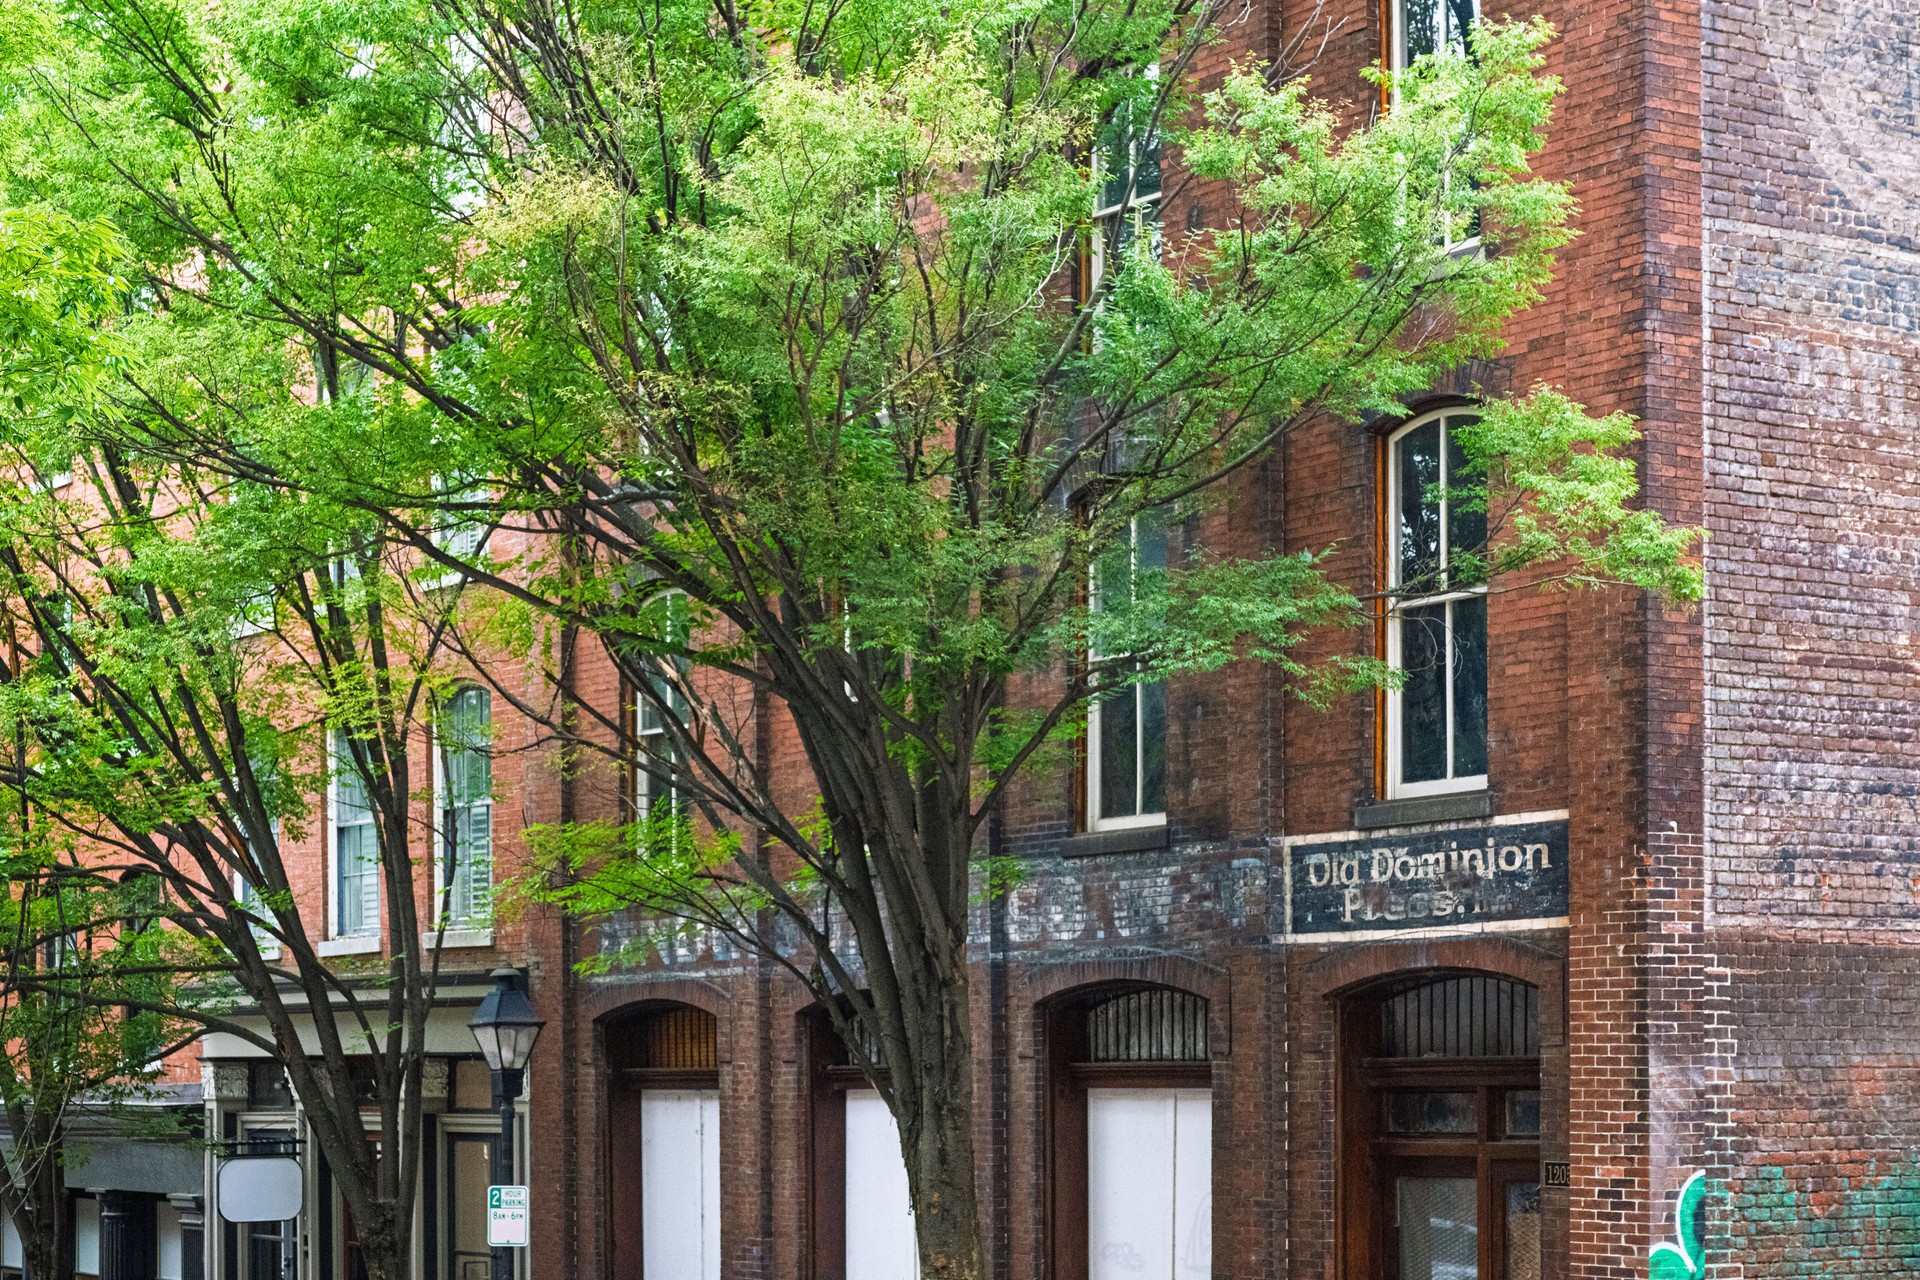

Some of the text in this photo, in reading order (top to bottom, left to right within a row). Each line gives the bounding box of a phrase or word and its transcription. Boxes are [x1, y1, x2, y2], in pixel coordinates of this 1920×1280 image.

[1308, 837, 1552, 887] Old Dominion
[491, 1190, 500, 1205] 2
[505, 1190, 522, 1198] HOUR
[502, 1199, 525, 1207] PARKING
